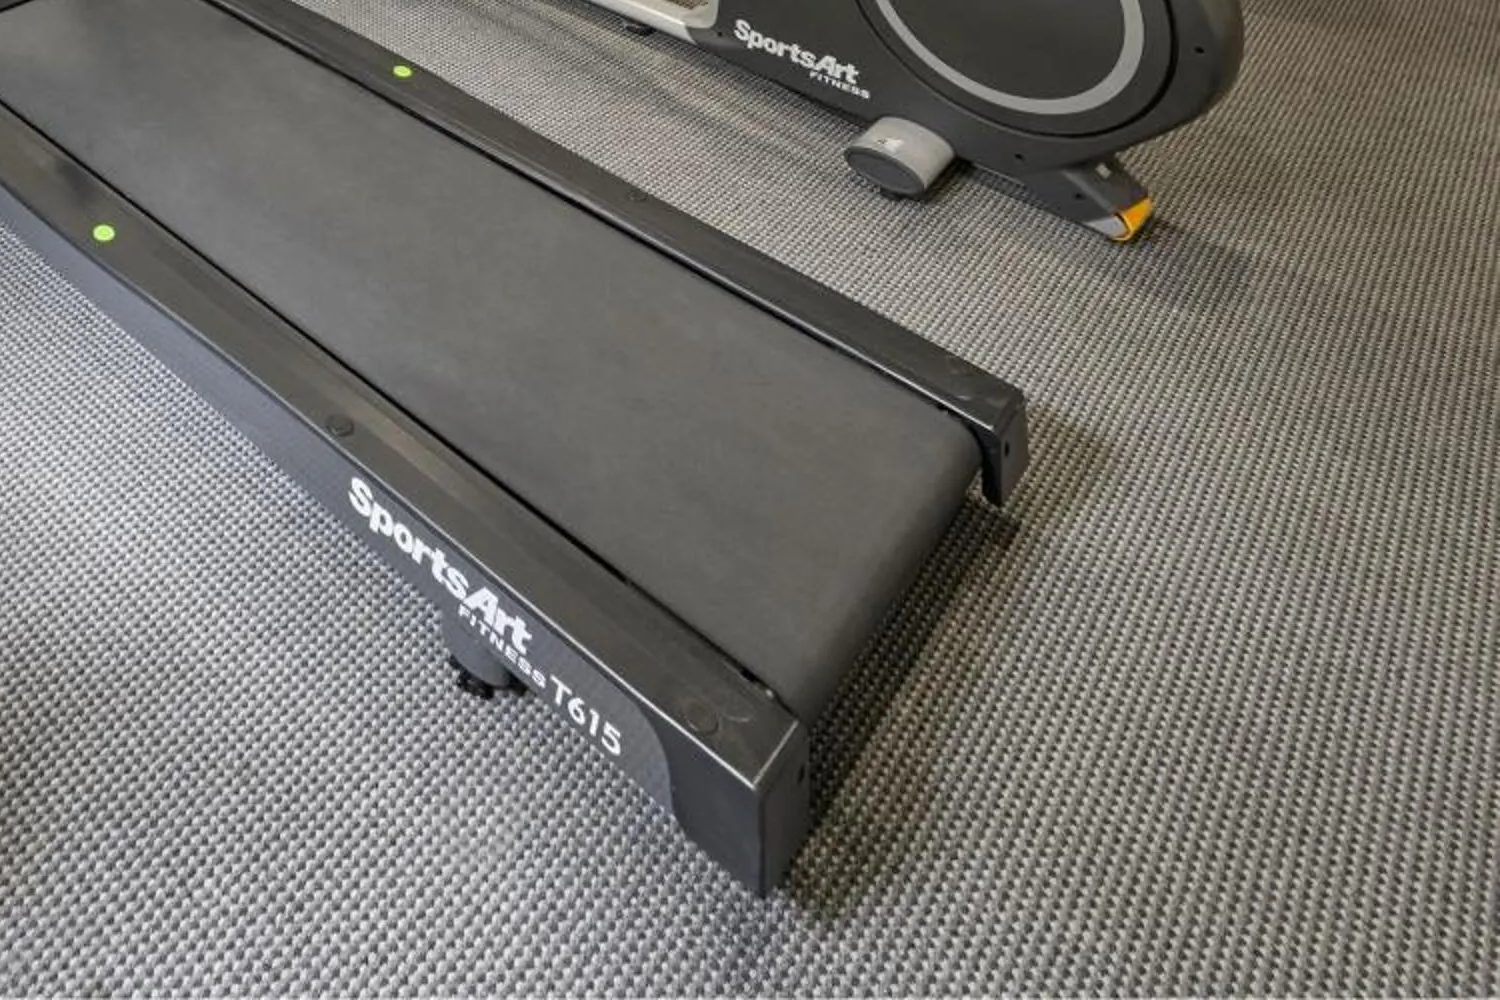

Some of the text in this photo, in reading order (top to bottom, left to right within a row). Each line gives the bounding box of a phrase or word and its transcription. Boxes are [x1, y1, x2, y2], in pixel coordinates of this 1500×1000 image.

[733, 18, 860, 85] SportsArt
[809, 70, 871, 100] FITNESS
[348, 476, 533, 656] SportsArt
[457, 602, 547, 689] FITNESS
[550, 673, 622, 757] T615
